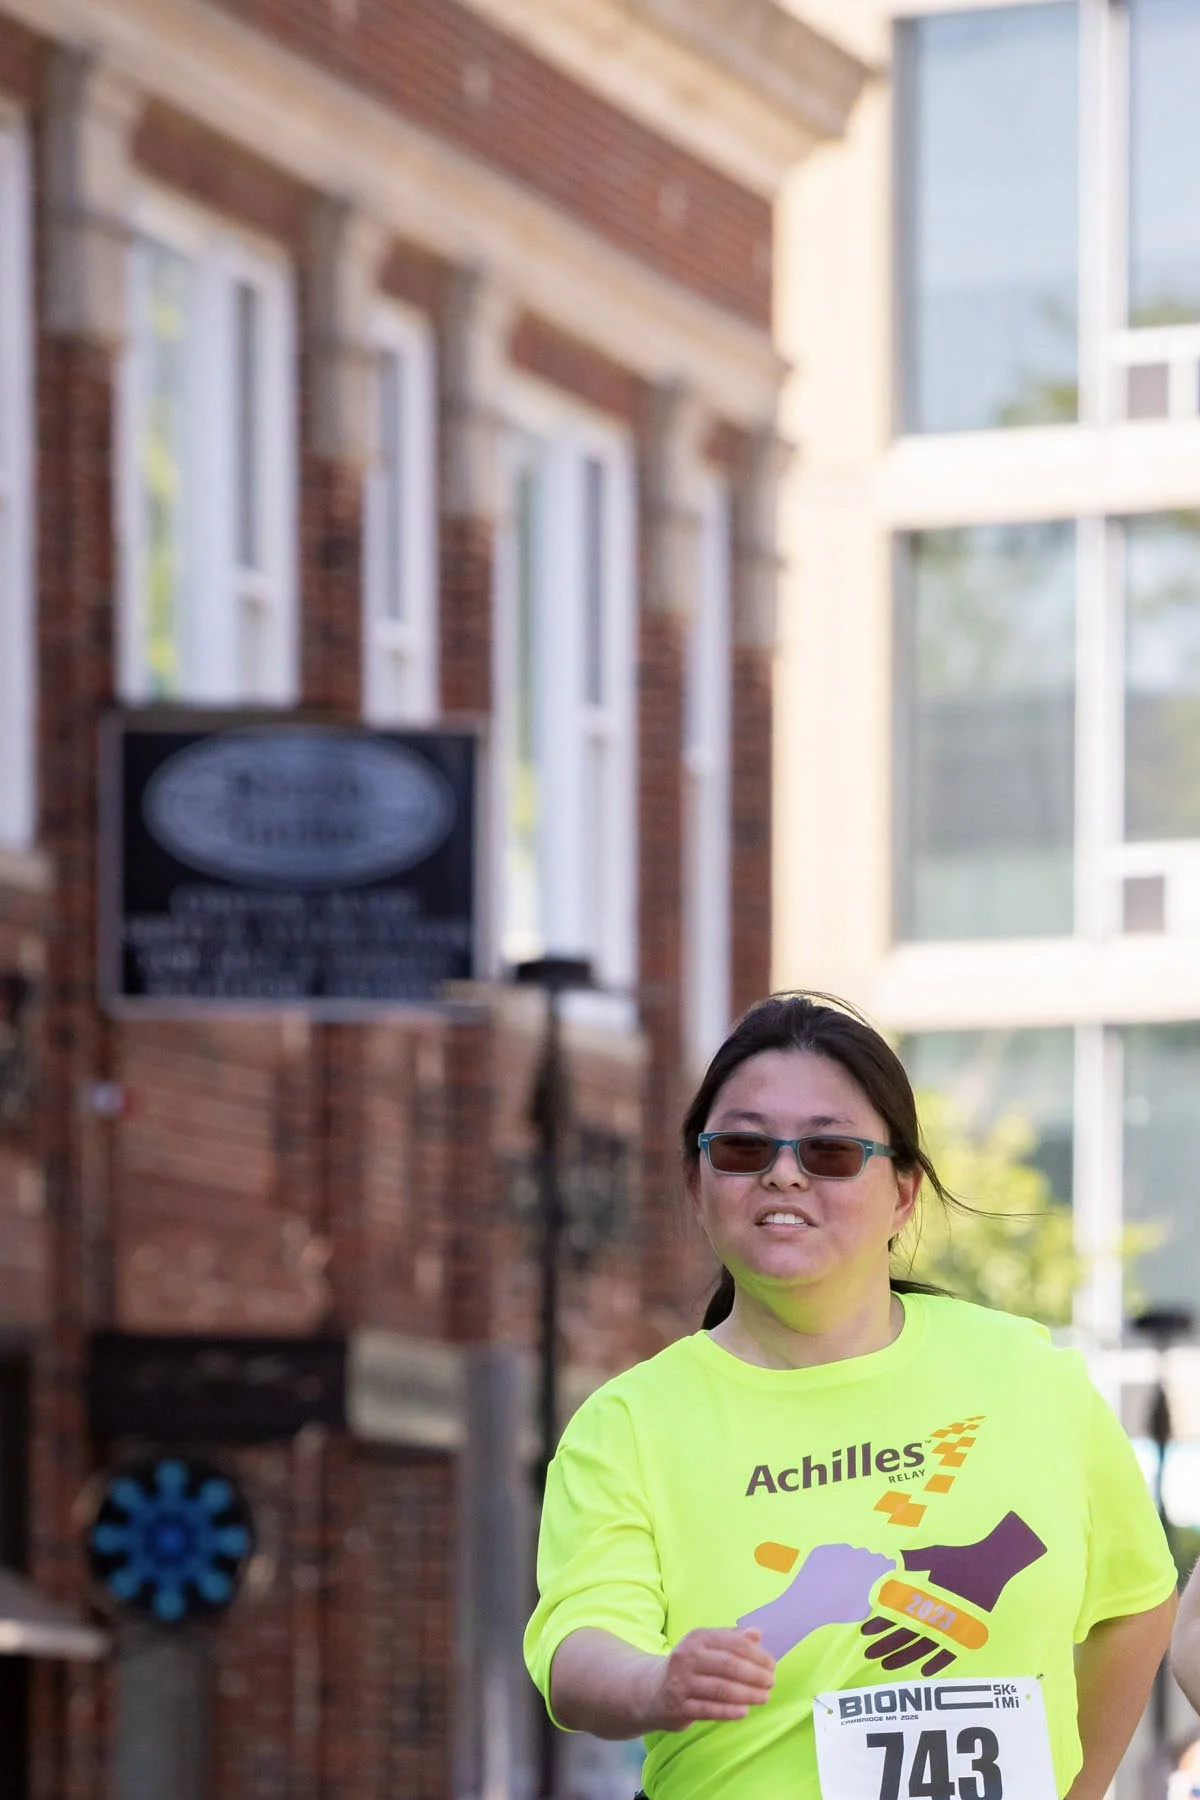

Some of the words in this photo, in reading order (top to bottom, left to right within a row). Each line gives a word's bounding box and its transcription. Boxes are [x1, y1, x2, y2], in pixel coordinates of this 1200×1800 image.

[745, 1442, 925, 1497] Achilles
[888, 1469, 926, 1484] RELAY
[838, 1684, 993, 1719] BIONIC
